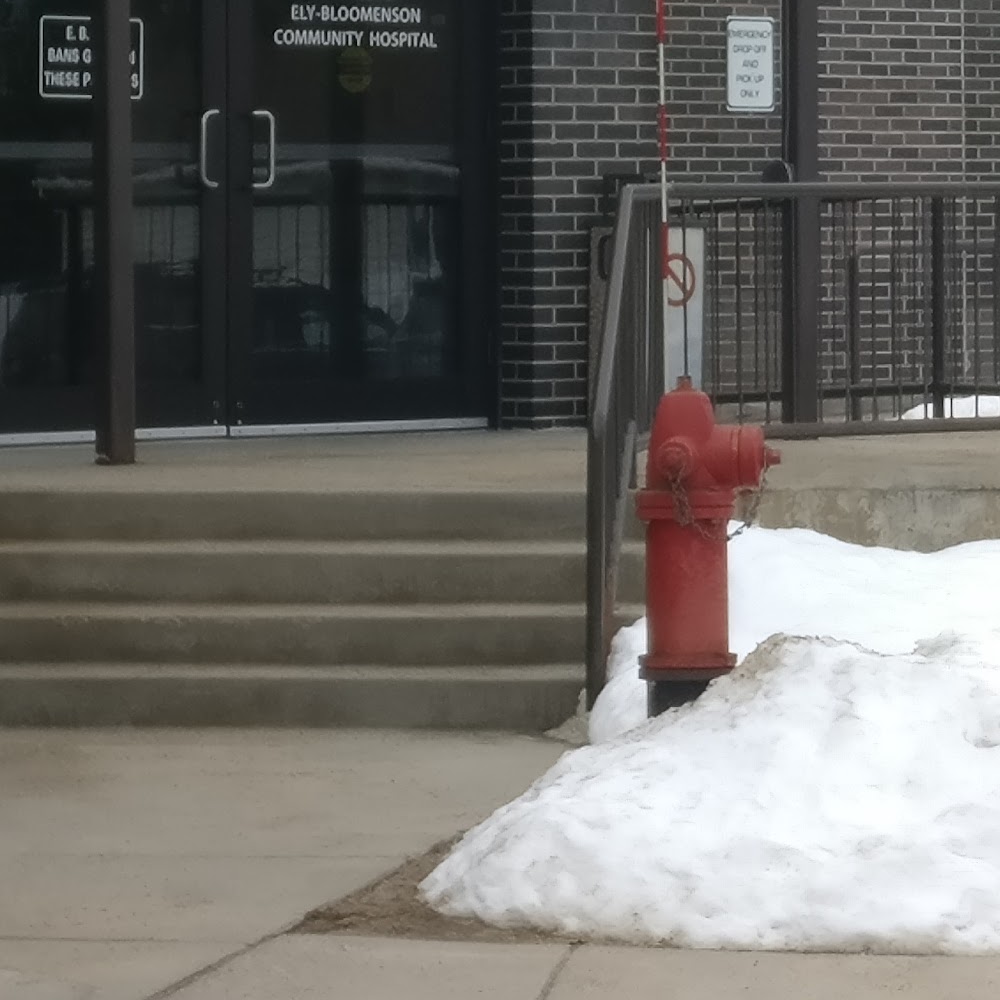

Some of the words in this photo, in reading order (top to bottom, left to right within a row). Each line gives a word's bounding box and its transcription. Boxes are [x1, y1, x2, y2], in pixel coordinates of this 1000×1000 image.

[291, 4, 422, 24] ELY-BLOOMENSON
[273, 29, 364, 47] COMMUNITY
[369, 31, 438, 48] HOSPITAL
